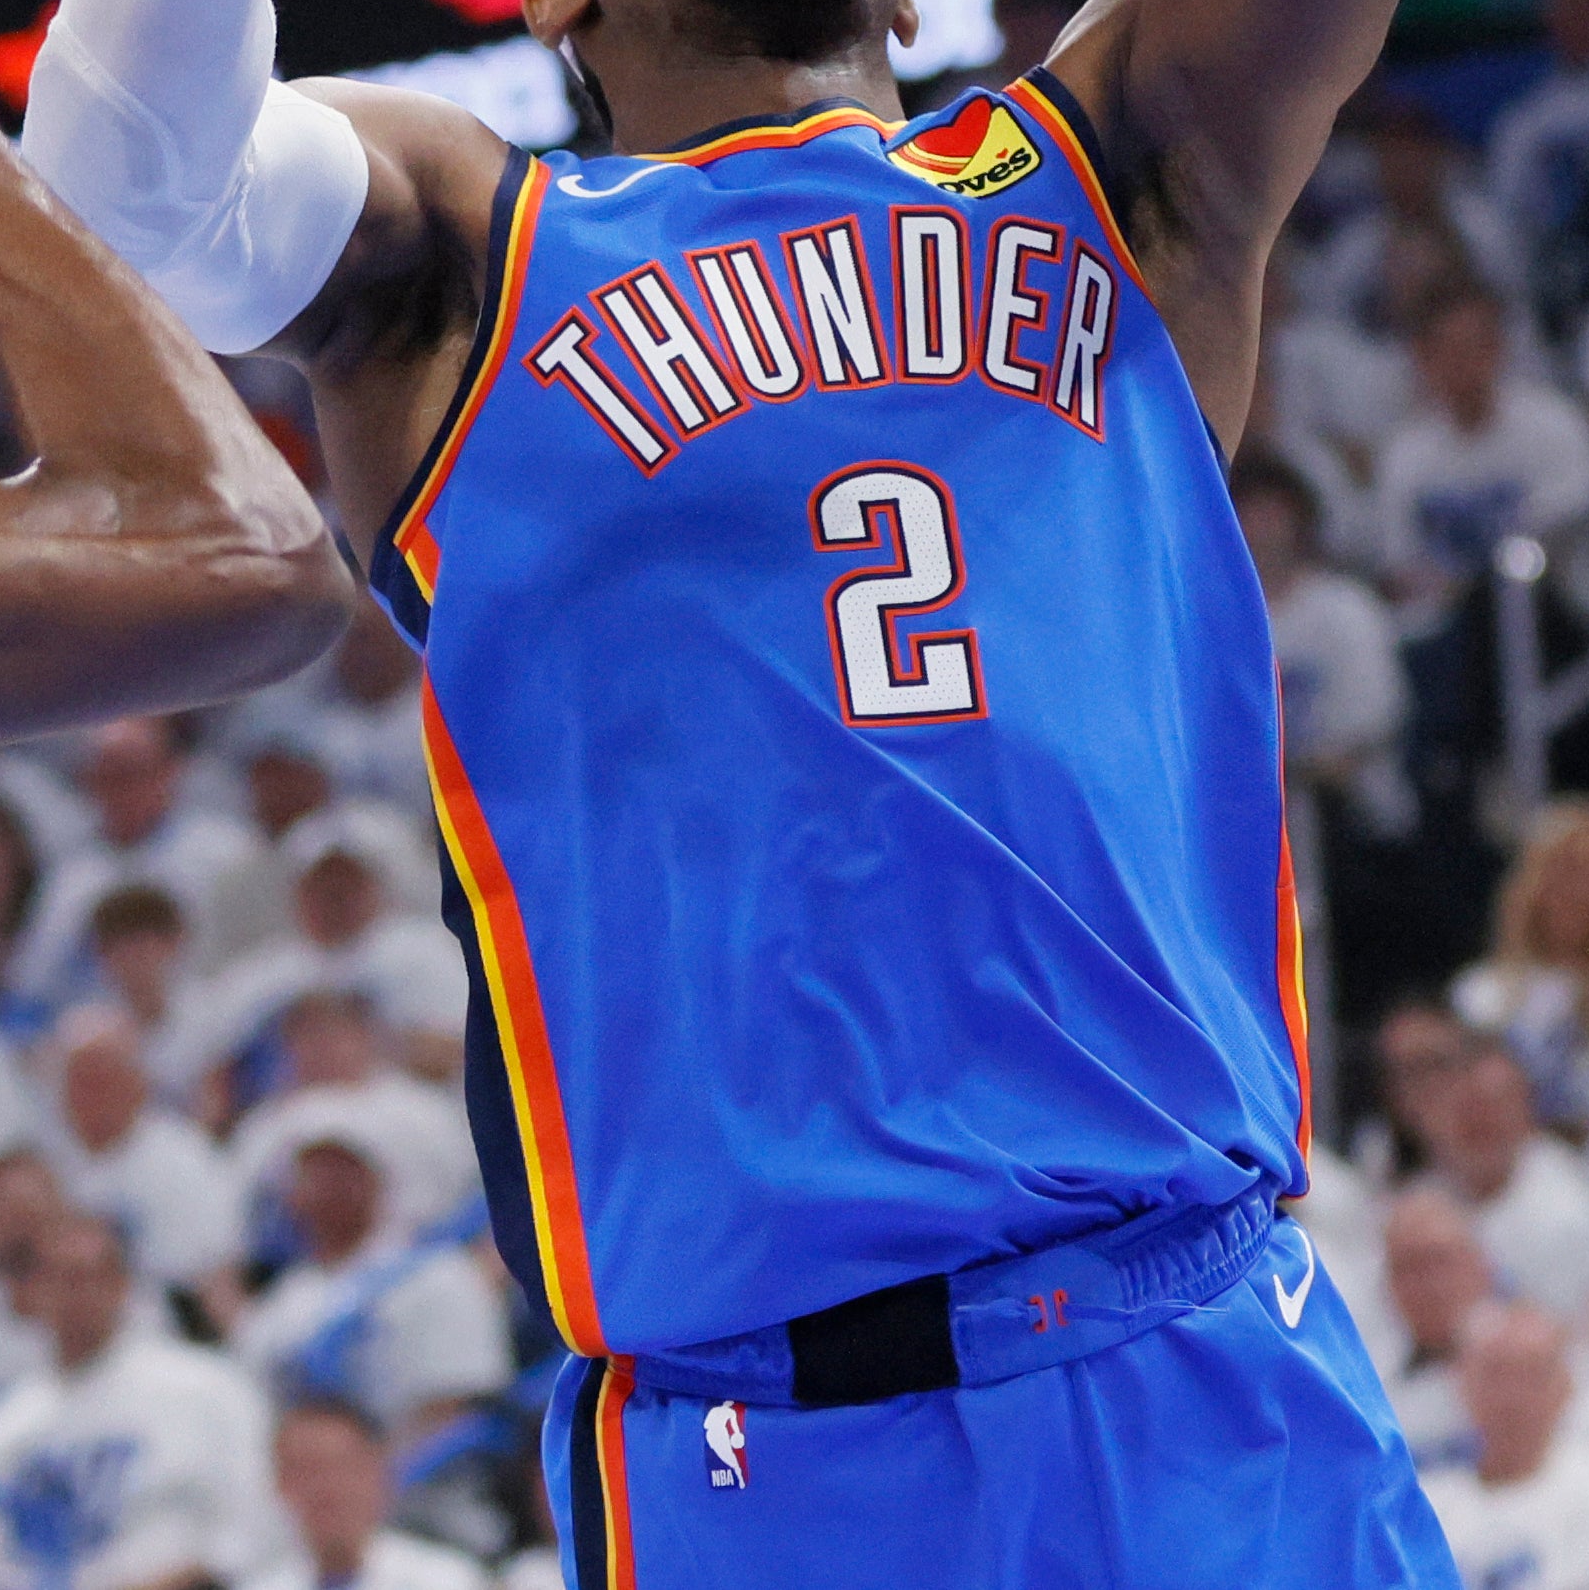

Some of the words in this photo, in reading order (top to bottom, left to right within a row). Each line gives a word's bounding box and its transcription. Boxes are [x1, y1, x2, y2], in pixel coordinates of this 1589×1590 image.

[521, 205, 1118, 479] THUNDER
[807, 459, 989, 728] 2
[711, 1469, 735, 1487] NBA
